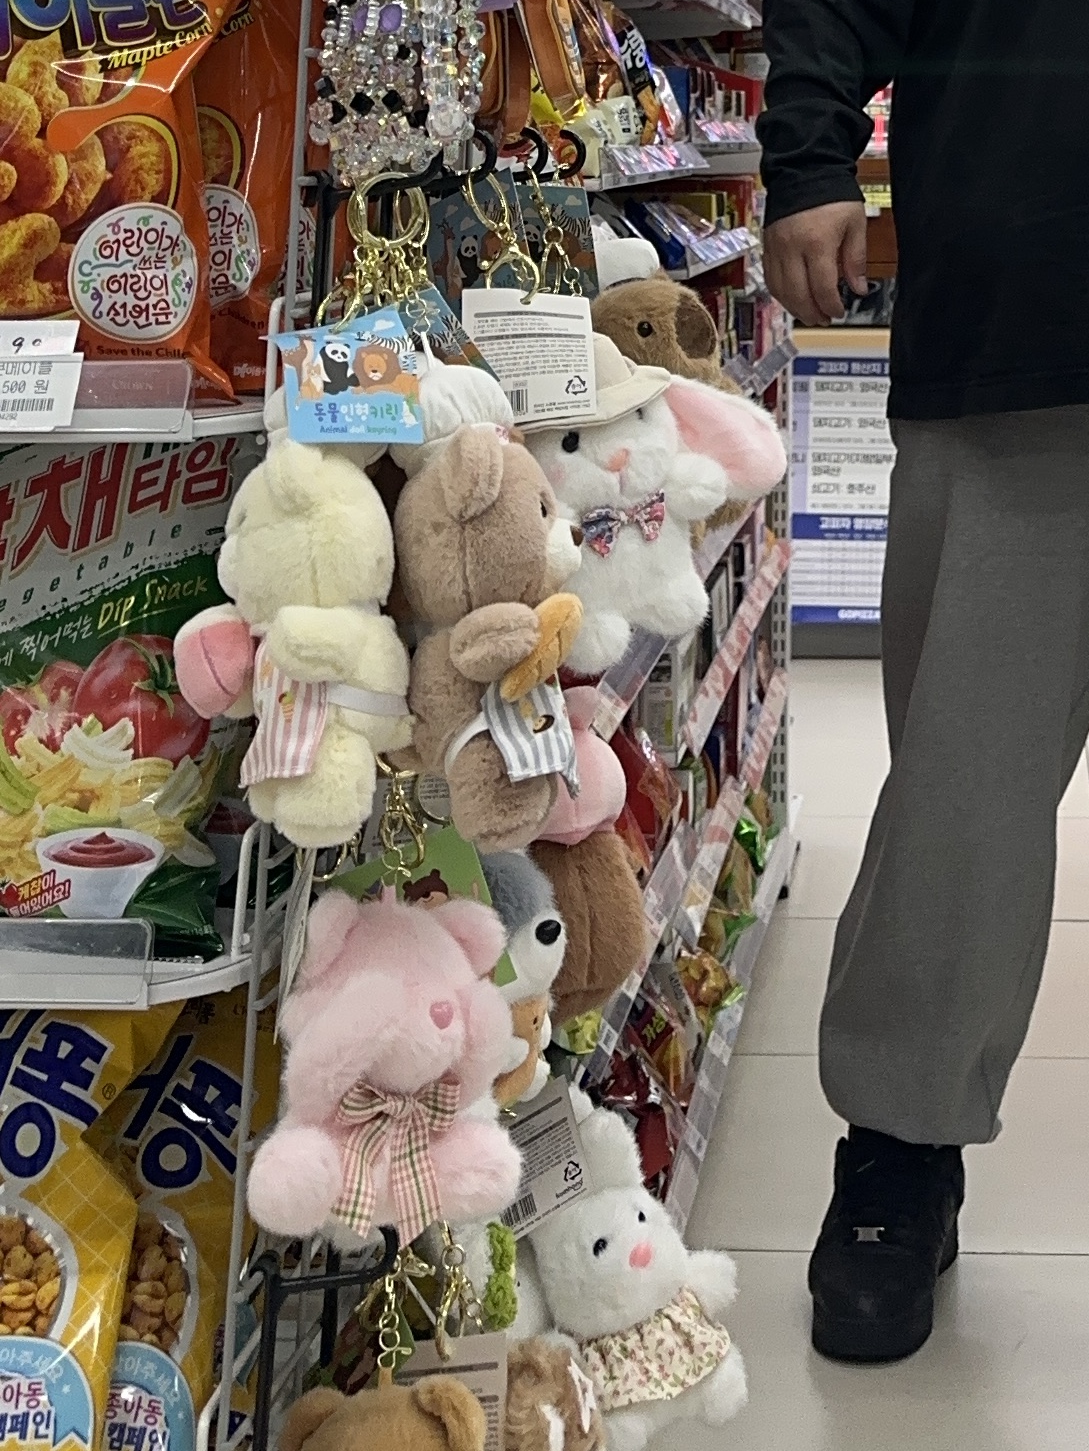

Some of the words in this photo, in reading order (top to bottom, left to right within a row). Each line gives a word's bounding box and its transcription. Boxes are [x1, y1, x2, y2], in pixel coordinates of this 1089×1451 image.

[221, 11, 255, 38] Corn
[107, 38, 173, 70] Maple
[171, 21, 214, 47] Corn
[105, 271, 169, 301] 어린이
[96, 345, 128, 357] Save
[131, 347, 152, 358] the
[154, 348, 188, 359] Chil
[34, 378, 50, 395] 원
[314, 402, 399, 424] 동물인형키링
[319, 424, 348, 434] Animal
[0, 1379, 46, 1410] 아동
[104, 1391, 164, 1427] 종아동
